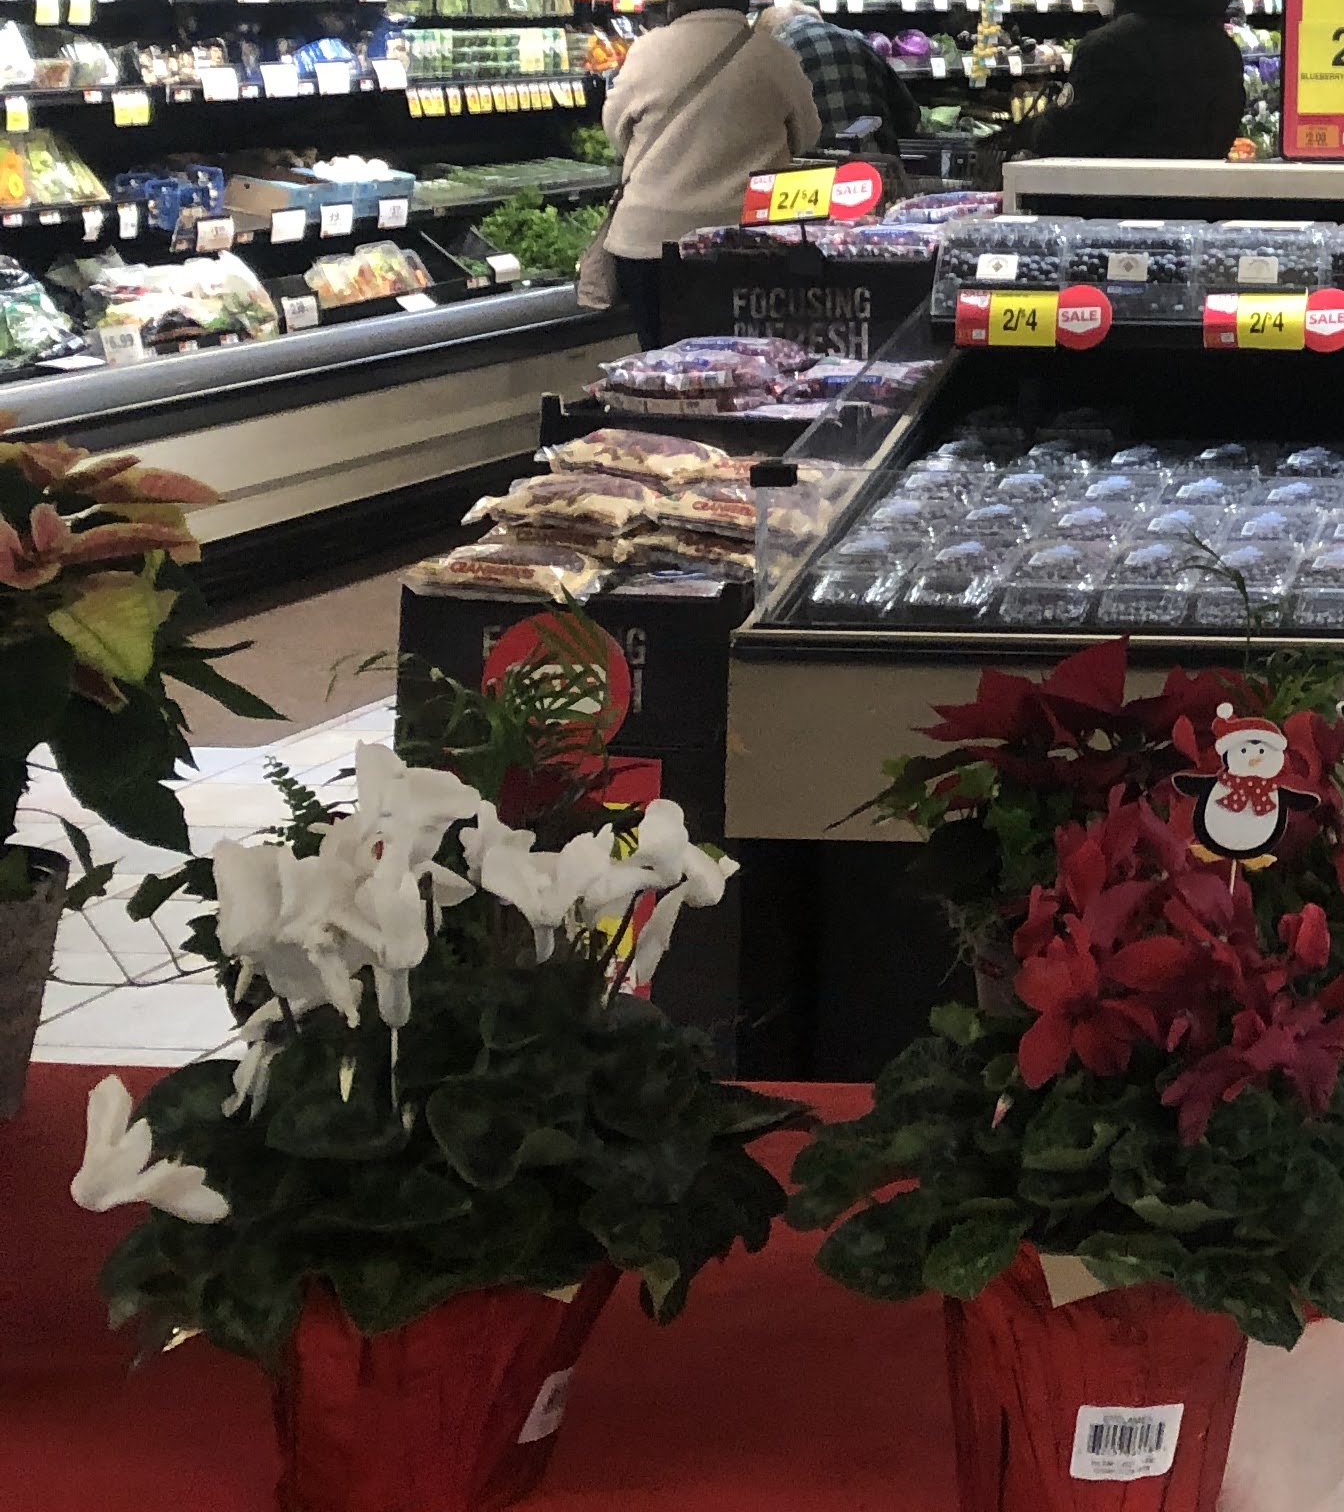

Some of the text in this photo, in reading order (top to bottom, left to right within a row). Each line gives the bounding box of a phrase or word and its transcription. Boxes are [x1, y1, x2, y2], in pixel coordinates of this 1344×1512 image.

[835, 182, 869, 196] SALE
[732, 287, 871, 320] FOCUSING
[1060, 308, 1098, 323] SALE
